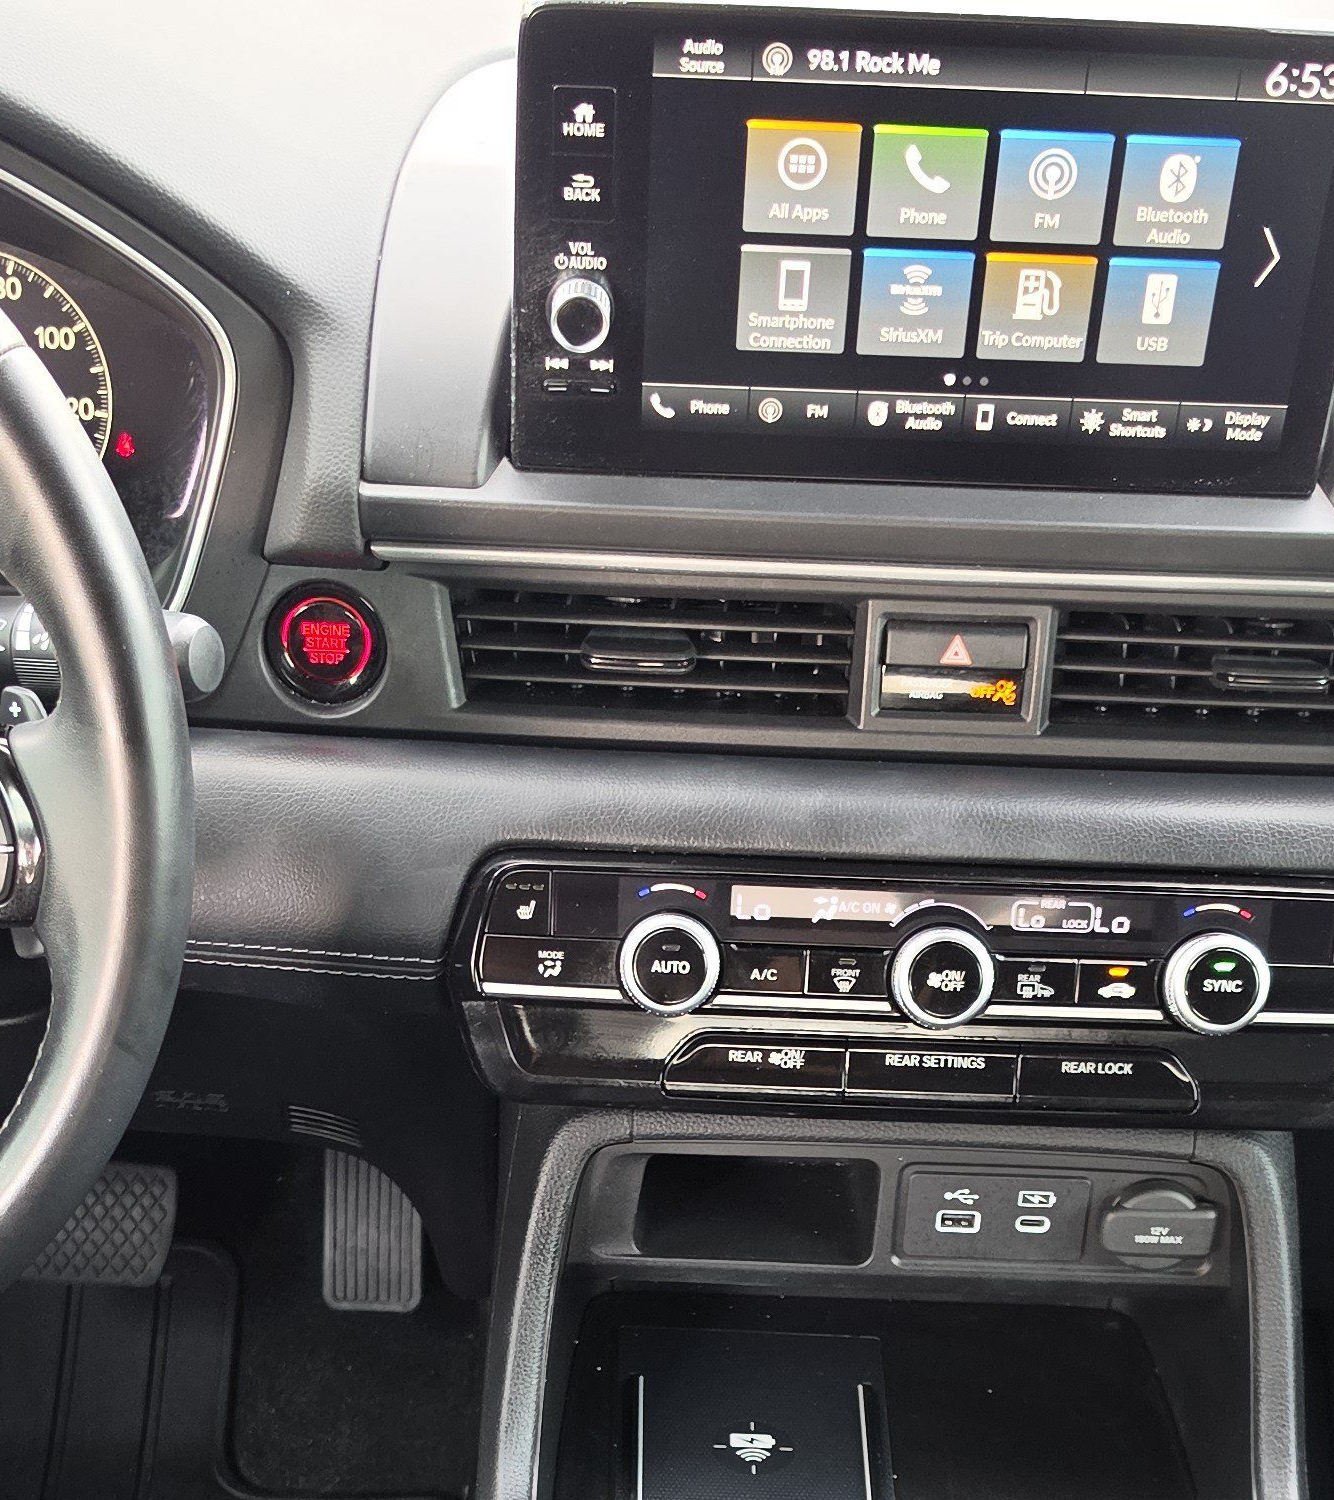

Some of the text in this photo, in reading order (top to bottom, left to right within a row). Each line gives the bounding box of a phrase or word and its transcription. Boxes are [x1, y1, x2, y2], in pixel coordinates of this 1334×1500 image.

[683, 38, 724, 56] Audio
[679, 57, 725, 75] Source
[807, 50, 942, 76] 98.1 Rock Me
[562, 122, 605, 138] HOME
[563, 186, 601, 202] BACK
[768, 203, 830, 224] All Apps
[899, 207, 947, 225] Phone
[1034, 212, 1061, 230] FM
[1136, 207, 1209, 225] Bluetooth
[1146, 227, 1190, 246] Audio
[568, 241, 595, 257] VOL
[569, 255, 608, 271] AUDIO
[748, 312, 835, 332] Smartphone
[33, 326, 76, 351] 100
[748, 332, 831, 350] Connection
[879, 327, 943, 346] SiriusXM
[982, 331, 1083, 352] Trip Computer
[1136, 336, 1168, 353] USB
[690, 400, 731, 416] Phone
[806, 403, 829, 419] FM
[895, 400, 955, 417] Bluetooth
[1121, 408, 1158, 424] Smart
[904, 416, 943, 432] Audio
[1006, 412, 1058, 428] Connect
[1224, 411, 1271, 430] Display
[1109, 423, 1166, 439] Shortcuts
[1225, 427, 1264, 443] Mode
[301, 621, 351, 637] ENGINE
[305, 637, 348, 649] START
[308, 652, 344, 665] STOP
[838, 902, 861, 914] A/C
[862, 902, 881, 914] ON
[1040, 899, 1066, 909] REAR
[1062, 918, 1088, 930] LOCK
[538, 951, 565, 960] MODE
[651, 960, 690, 974] AUTO
[750, 968, 778, 981] A/C
[831, 968, 861, 977] FRONT
[1018, 974, 1041, 982] REAR
[940, 981, 965, 992] OFF
[1203, 979, 1244, 994] SYNC
[728, 1049, 763, 1063] REAR
[780, 1059, 805, 1069] OFF
[885, 1054, 985, 1070] REAR SETTINGS
[1061, 1061, 1133, 1075] REAR LOCK
